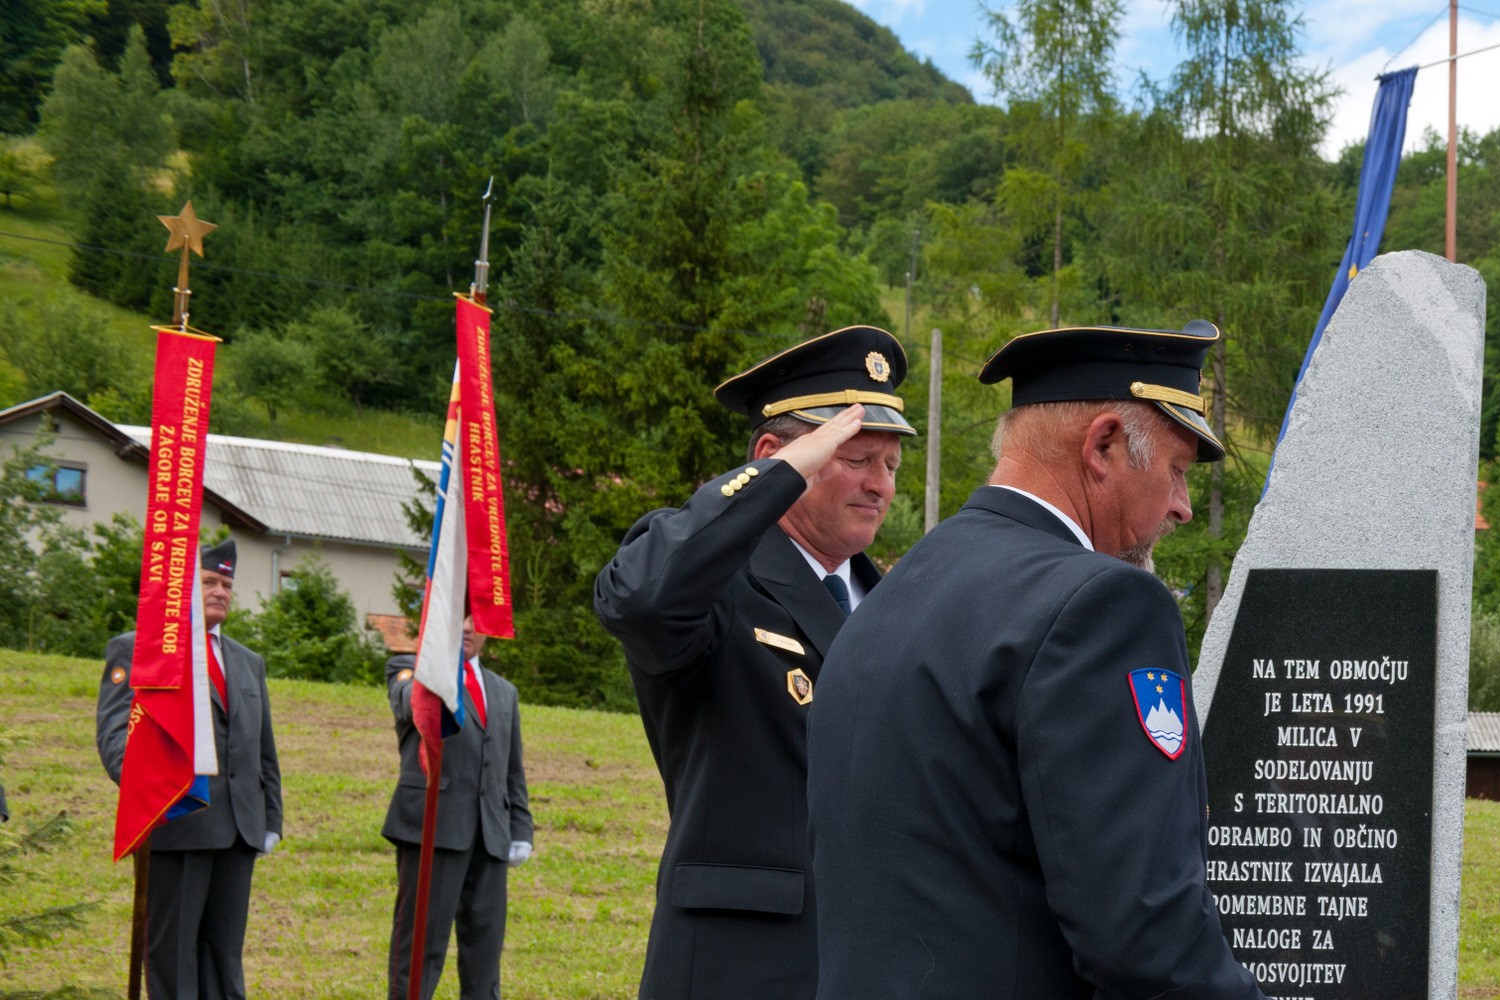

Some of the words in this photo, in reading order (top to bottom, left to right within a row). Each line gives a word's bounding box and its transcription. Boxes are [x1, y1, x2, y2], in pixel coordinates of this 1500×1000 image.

[181, 357, 206, 443] ZDRUŽENJE
[481, 411, 496, 470] BORCEV
[155, 424, 176, 504] ZAGORJE
[469, 421, 484, 503] HRASTNIK
[175, 446, 196, 509] BORCEV
[486, 472, 498, 491] ZA
[152, 509, 168, 533] OB
[173, 511, 191, 531] ZA
[487, 497, 503, 573] VREDNOTE
[149, 541, 166, 582] SAVI
[165, 537, 188, 618] VREDNOTE
[492, 575, 505, 606] NOB
[162, 622, 180, 655] NOB
[1252, 659, 1277, 679] NA
[1284, 660, 1320, 680] TEM
[1330, 656, 1409, 685] OBMOČJU
[1264, 693, 1282, 716] JE
[1292, 693, 1334, 714] LETA
[1343, 694, 1385, 714] 1991
[1277, 726, 1338, 747] MILICA
[1350, 727, 1362, 747] V
[1254, 759, 1374, 786] SODELOVANJU
[1234, 793, 1244, 813] S
[1255, 793, 1384, 815] TERITORIALNO
[1208, 826, 1292, 847] OBRAMBO
[1303, 827, 1322, 848] IN
[1334, 824, 1398, 849] OBČINO
[1206, 861, 1293, 882] HRASTNIK
[1304, 862, 1383, 887] IZVAJALA
[1317, 896, 1368, 921] TAJNE
[1232, 928, 1301, 949] NALOGE
[1312, 930, 1334, 950] ZA
